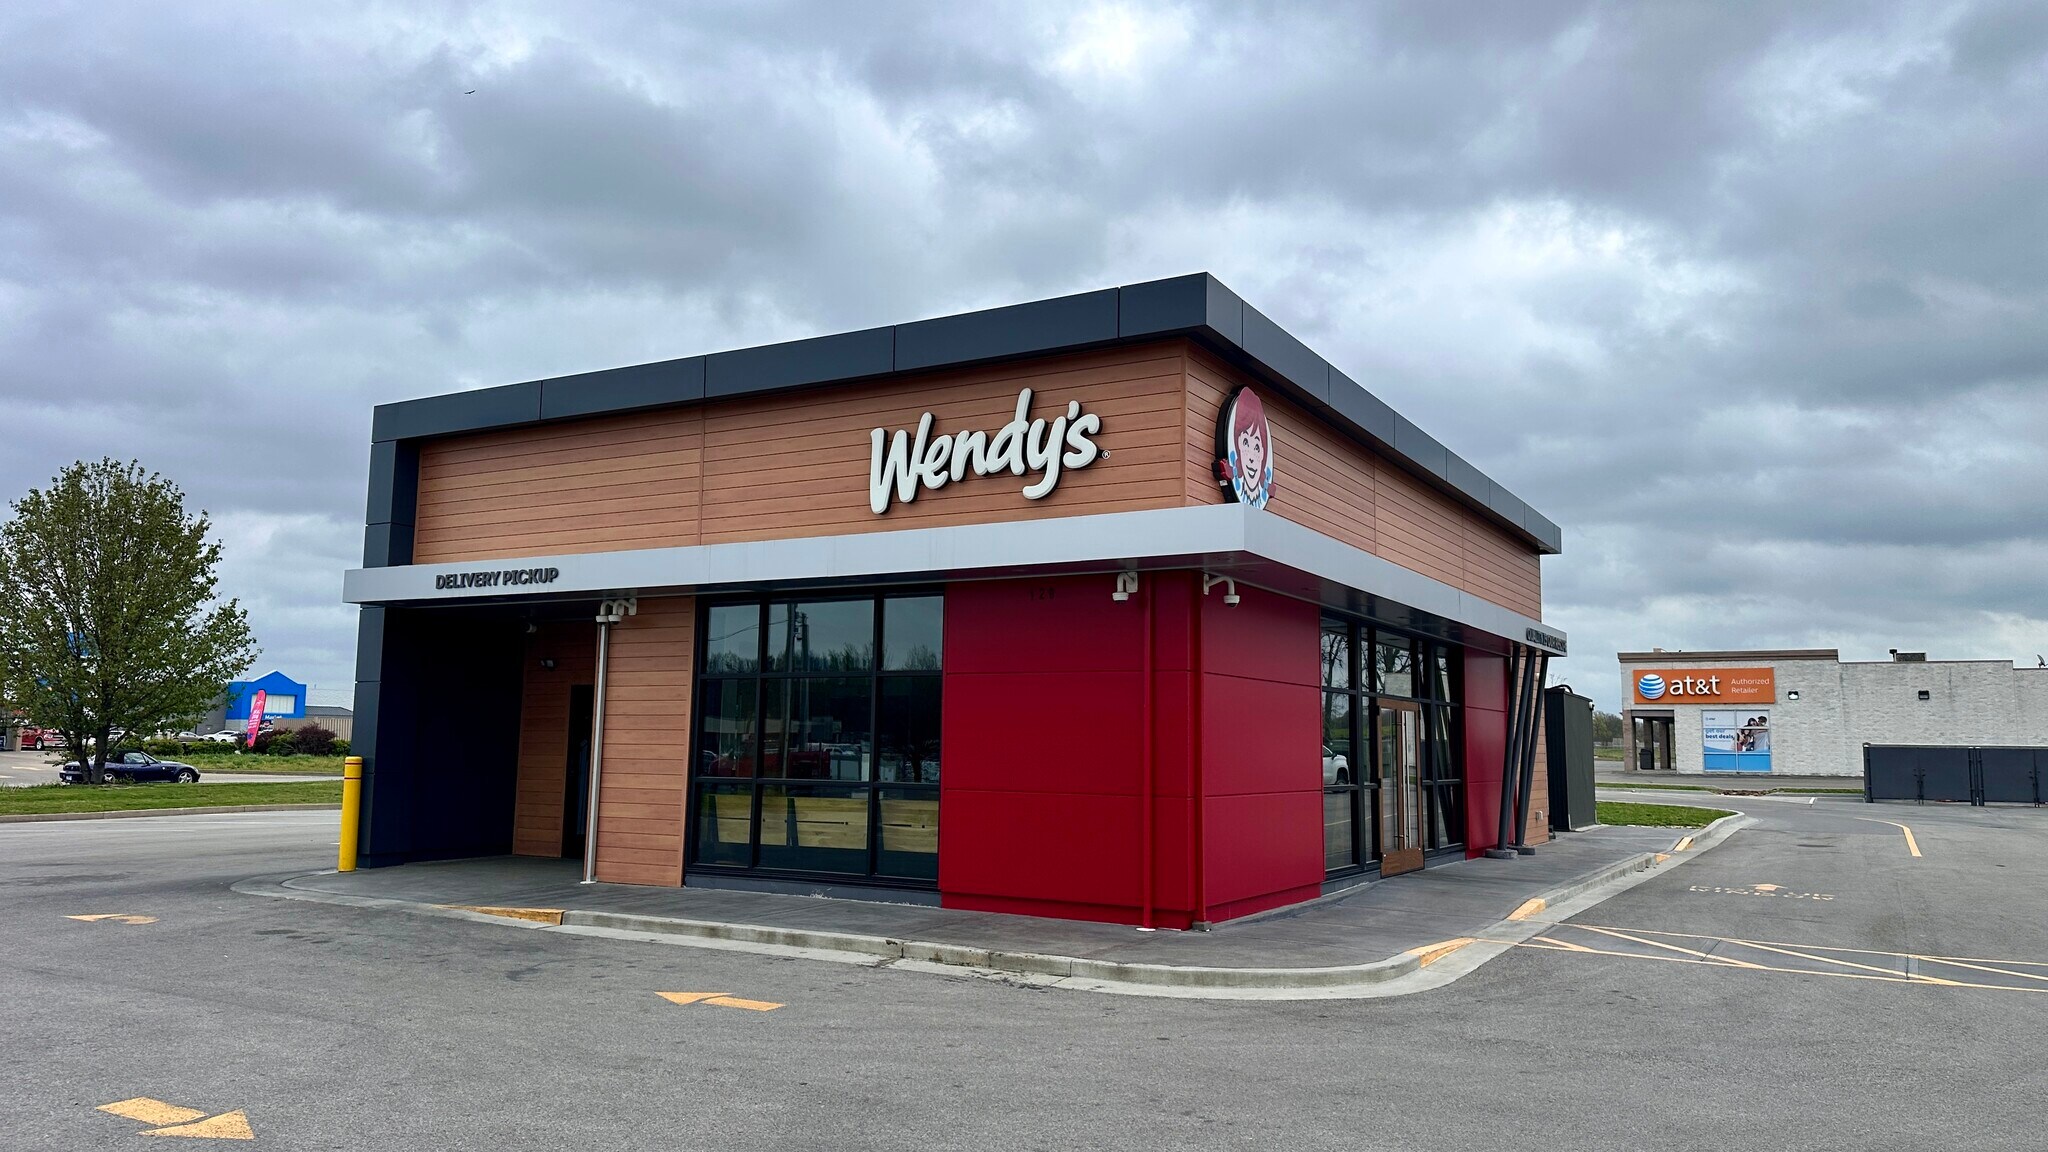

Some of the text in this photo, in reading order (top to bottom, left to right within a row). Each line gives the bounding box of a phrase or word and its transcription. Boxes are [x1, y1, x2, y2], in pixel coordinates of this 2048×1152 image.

[870, 388, 1102, 514] Wendy's
[435, 567, 559, 589] DELIVERY PICKUP
[1669, 675, 1721, 695] at&t
